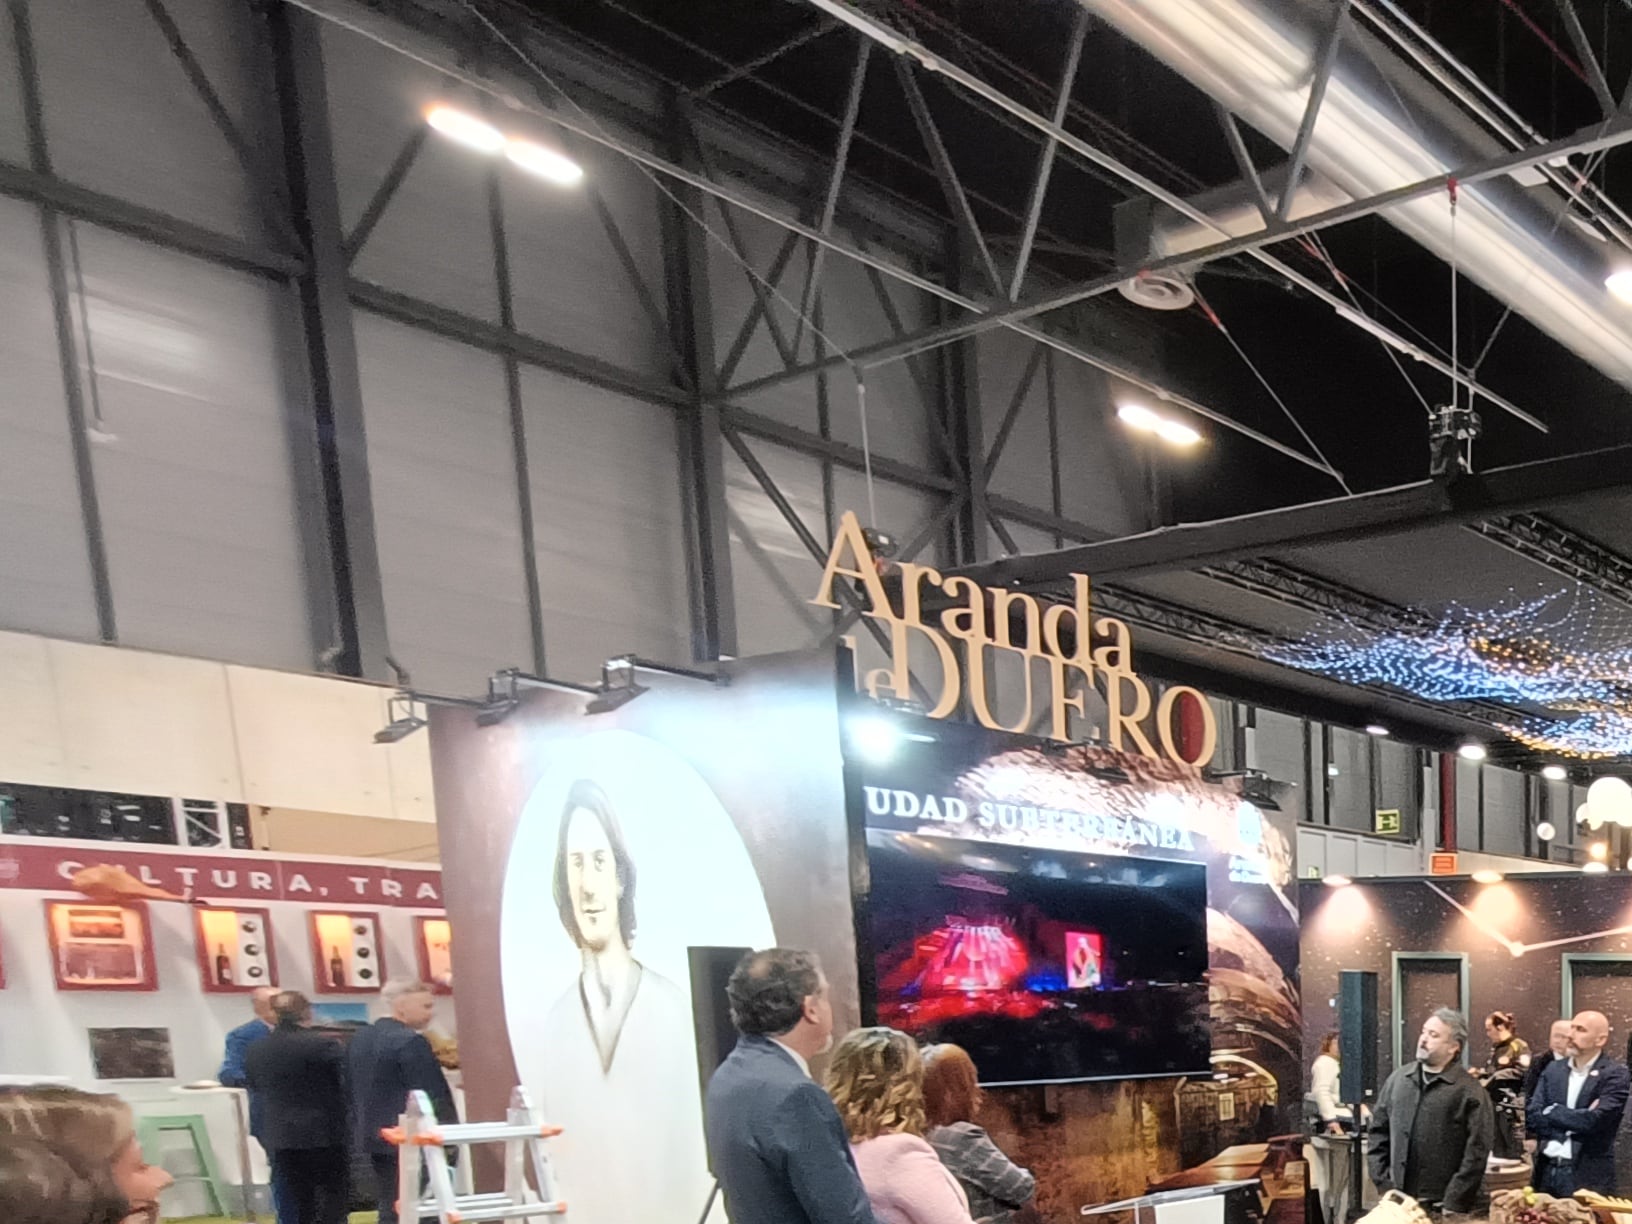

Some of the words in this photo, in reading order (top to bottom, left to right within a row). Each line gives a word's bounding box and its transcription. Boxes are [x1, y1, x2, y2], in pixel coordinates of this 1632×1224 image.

[807, 510, 1137, 676] Aranda
[979, 801, 1195, 851] SUBTERRÁNEA
[57, 861, 329, 897] CLTURA,
[347, 876, 439, 900] TRA
